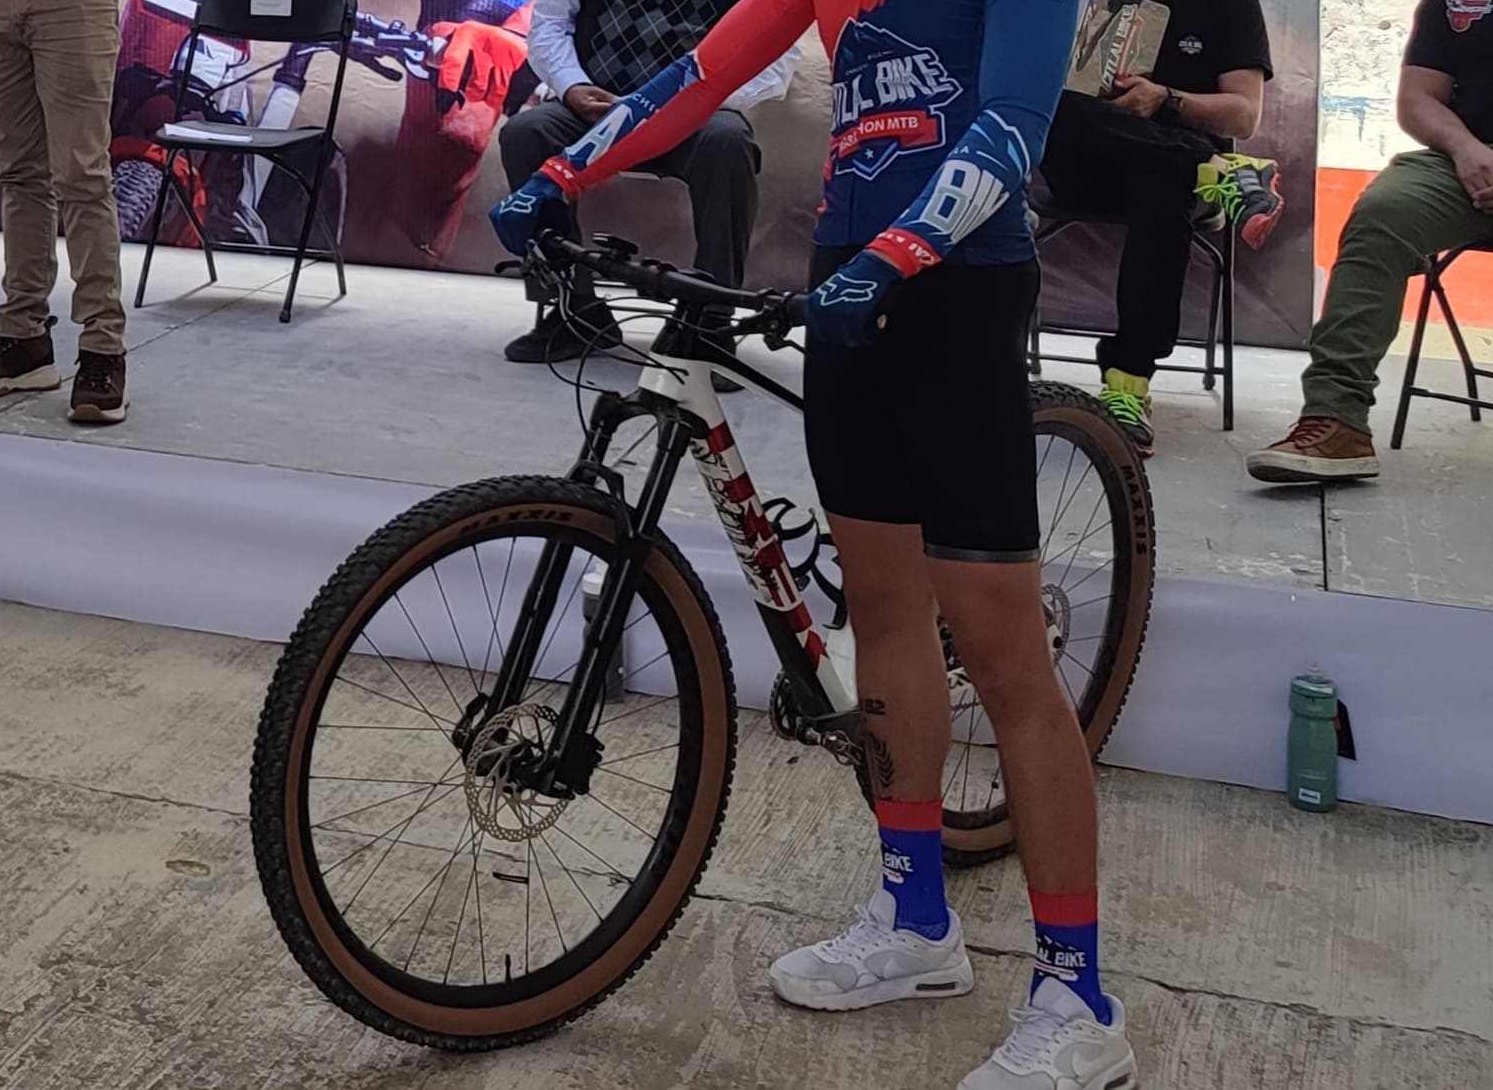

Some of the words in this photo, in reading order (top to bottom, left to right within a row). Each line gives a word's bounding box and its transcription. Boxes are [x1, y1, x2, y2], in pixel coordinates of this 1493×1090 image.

[875, 53, 955, 107] BIKE
[887, 116, 919, 130] MTB
[884, 852, 914, 872] BIKE
[1054, 951, 1087, 967] BIKE
